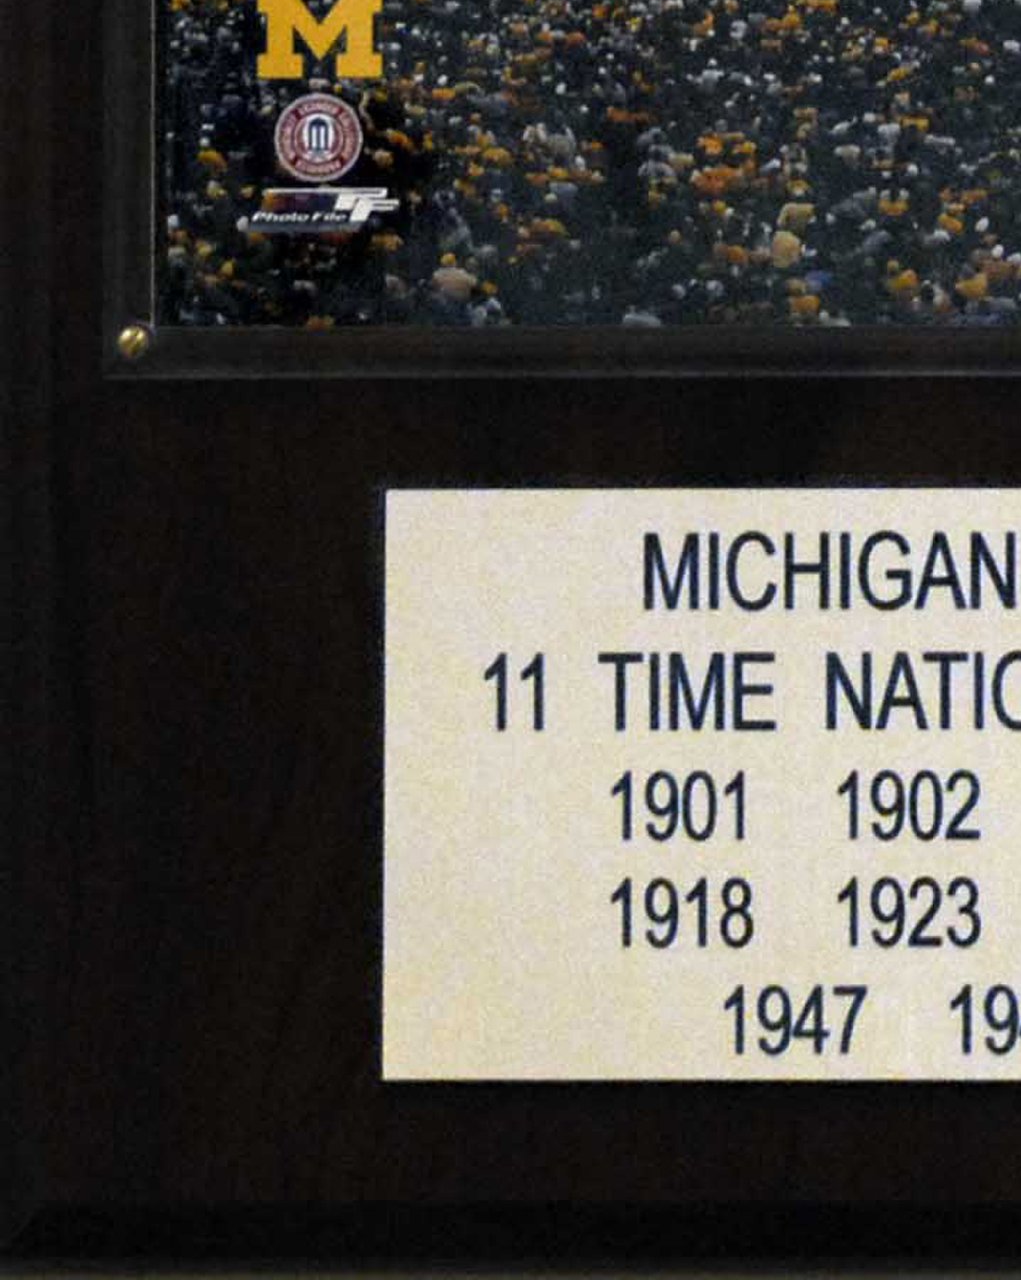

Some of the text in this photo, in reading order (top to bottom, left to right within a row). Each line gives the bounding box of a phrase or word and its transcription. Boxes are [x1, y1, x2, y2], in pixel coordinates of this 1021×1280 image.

[644, 530, 1016, 611] MICHIGAN
[484, 653, 543, 731] 11
[598, 652, 776, 731] TIME
[611, 771, 744, 841] 1901
[838, 770, 980, 841] 1902
[611, 878, 753, 949] 1918
[838, 877, 981, 948] 1923
[724, 985, 867, 1056] 1947
